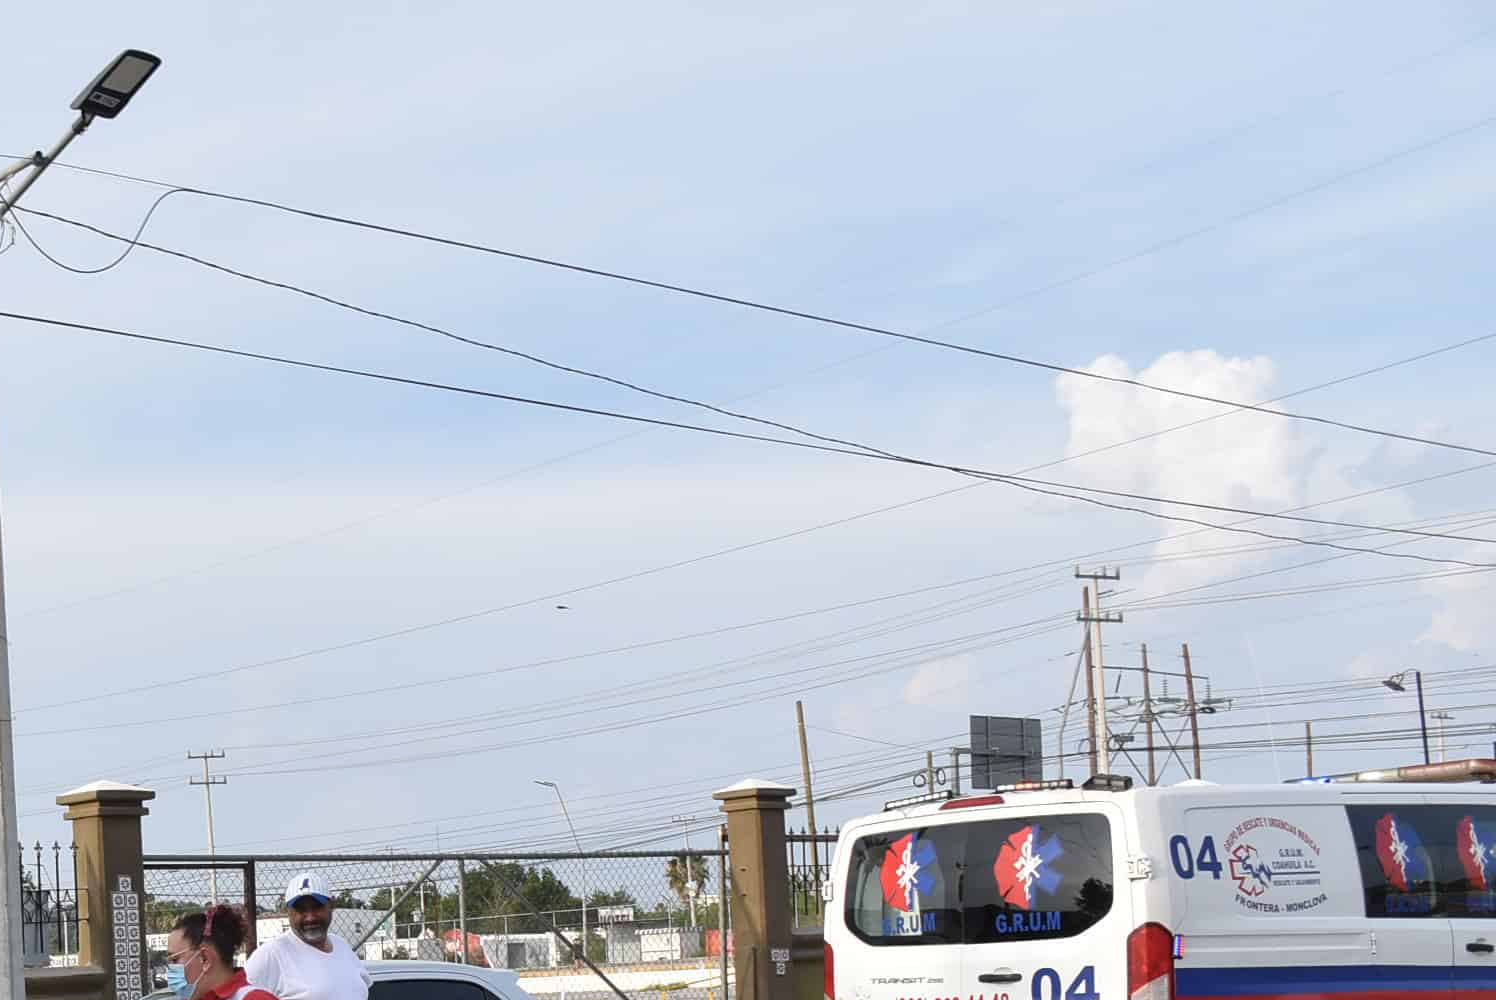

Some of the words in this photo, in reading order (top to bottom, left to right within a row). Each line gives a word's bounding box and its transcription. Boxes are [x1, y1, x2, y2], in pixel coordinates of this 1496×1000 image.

[1169, 834, 1223, 880] 04
[1235, 893, 1280, 913] FRONTERA
[1286, 893, 1328, 913] MONCLOVA
[995, 911, 1062, 933] G.R.U.M
